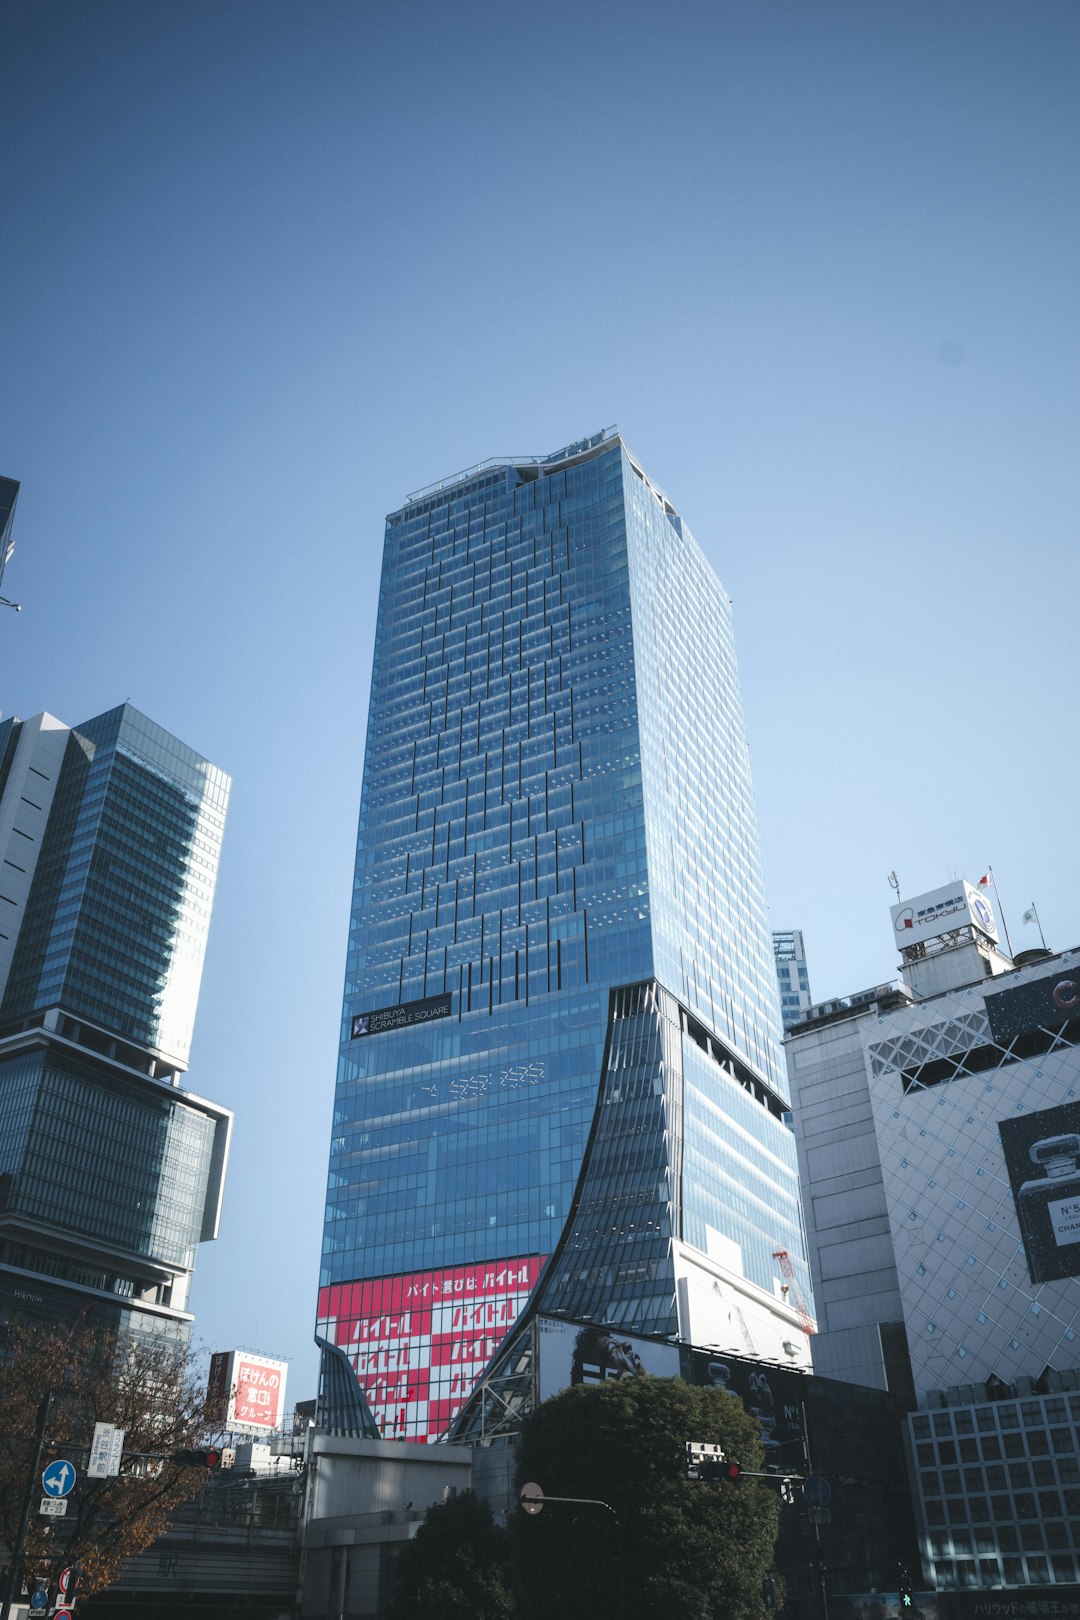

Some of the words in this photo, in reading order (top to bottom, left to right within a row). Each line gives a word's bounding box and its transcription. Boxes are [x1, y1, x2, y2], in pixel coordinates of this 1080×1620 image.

[914, 903, 967, 925] TOKYU
[370, 1008, 406, 1023] SHIBUYA
[370, 1014, 413, 1031] SCRAMBLE
[414, 1005, 449, 1020] SQUARE
[407, 1277, 478, 1298] バイト選びは
[482, 1265, 529, 1289] バイトル
[353, 1310, 413, 1340] バイトル
[452, 1297, 516, 1327] バイトル
[451, 1331, 506, 1361] バイト
[240, 1366, 279, 1389] ほけんの
[240, 1406, 272, 1421] グループ
[96, 1428, 111, 1473] 渋谷駅前
